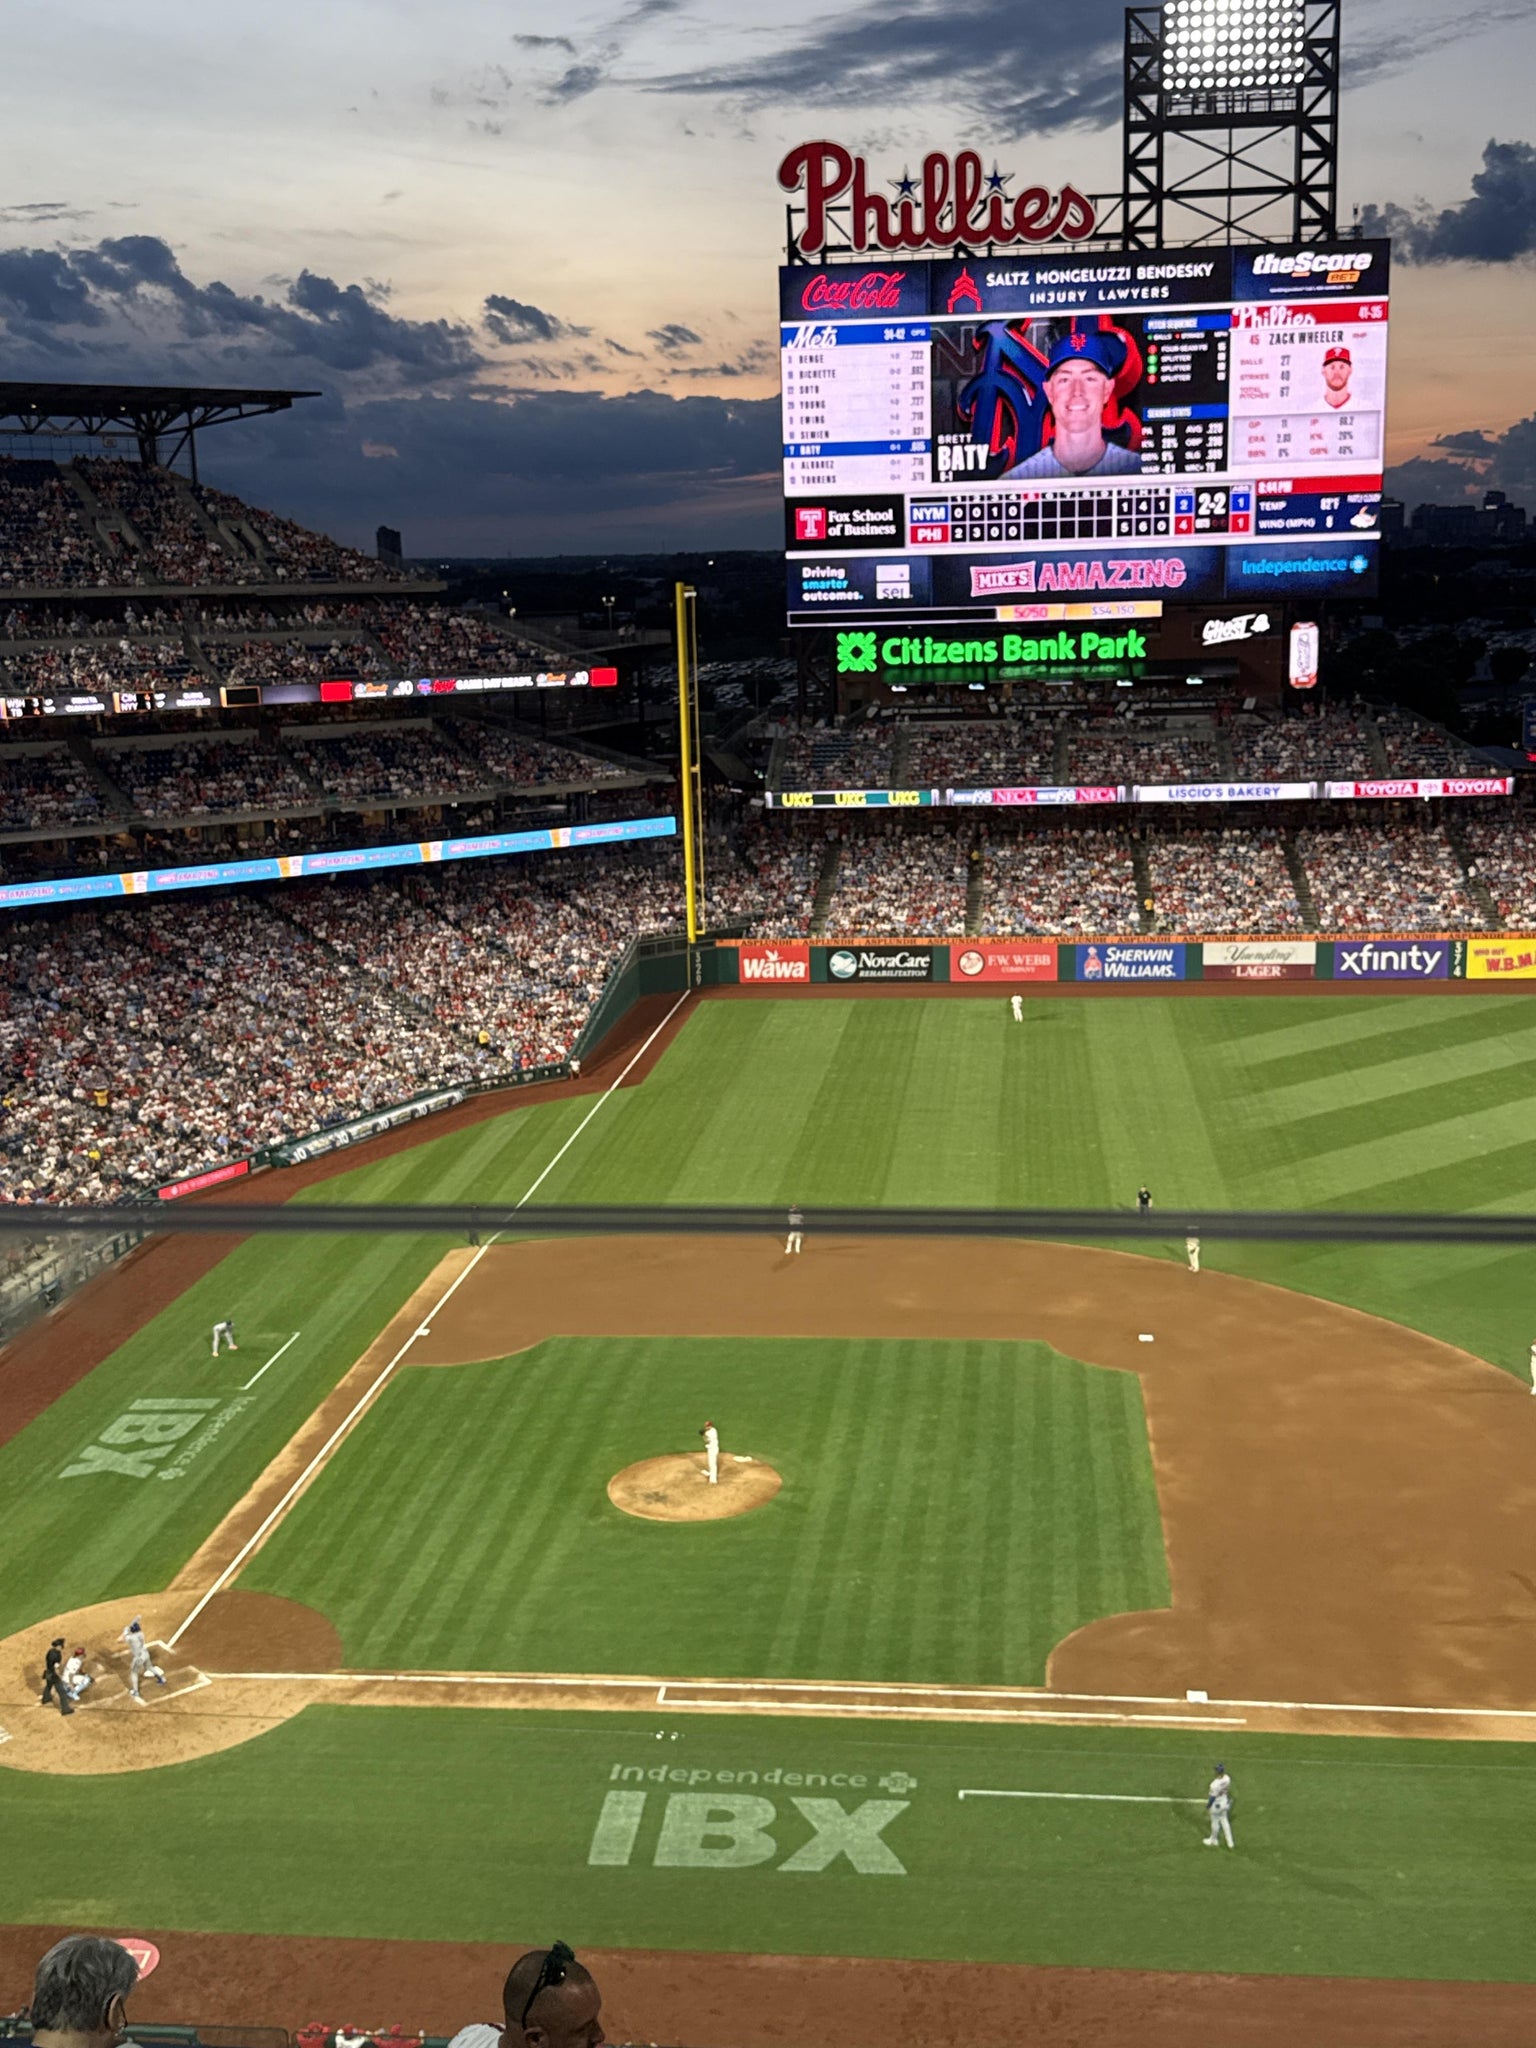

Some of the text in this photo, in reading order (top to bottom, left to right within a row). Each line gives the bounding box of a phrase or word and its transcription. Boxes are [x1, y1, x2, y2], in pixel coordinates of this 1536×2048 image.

[777, 139, 1096, 254] Phillies
[1252, 251, 1372, 275] theScore
[986, 262, 1214, 287] SALTZ MONGELUZZI BENDESKY
[1331, 273, 1356, 281] BET
[1030, 286, 1169, 304] INJURY LAWYERS
[1232, 304, 1317, 327] Phillies
[787, 325, 838, 347] Mets
[1249, 330, 1344, 345] 45 ZACK WHEELER
[799, 369, 836, 379] BICHETTE
[799, 385, 819, 394] SOTO
[800, 400, 825, 409] YOUNG
[800, 415, 825, 424] EWING
[801, 430, 829, 439] SEMIEN
[800, 445, 821, 455] BATY
[938, 444, 989, 470] BATY
[801, 460, 834, 470] ALVAREZ
[801, 475, 836, 484] TORRENS
[912, 500, 1166, 520] NYM 0 0 1 0 1 4 1
[1179, 499, 1188, 510] 2
[1198, 492, 1227, 515] 2-2
[1237, 497, 1244, 509] 1
[1259, 500, 1287, 511] TEMP
[828, 509, 893, 522] Fox School
[828, 522, 896, 536] of Business
[1179, 519, 1188, 530] 4
[1237, 517, 1244, 529] 1
[1258, 518, 1285, 529] WIND
[917, 528, 942, 541] PHI
[954, 528, 963, 539] 2
[972, 527, 981, 538] 3
[990, 526, 999, 538] 0
[1008, 525, 1018, 537] 0
[1121, 521, 1129, 533] 5
[1157, 520, 1167, 532] 0
[802, 566, 845, 580] Driving
[1242, 558, 1346, 576] Independence
[979, 570, 1029, 589] MIKE'S
[1038, 558, 1187, 591] AMAZING
[802, 579, 849, 590] smarter
[802, 590, 864, 601] outcomes.
[882, 629, 1146, 665] Citizens Bank Park
[994, 788, 1034, 801] NECA
[1077, 787, 1115, 800] NECA
[1168, 785, 1280, 799] LISCIO'S BAKERY
[1357, 781, 1502, 795] TOYOTA TOYOTA
[781, 791, 920, 807] UKG UKG UKG
[858, 952, 930, 968] NovaCare
[987, 954, 1051, 967] F.W. WEBB
[1105, 946, 1173, 962] SHERWIN
[1223, 944, 1295, 964] Yuengling
[1340, 943, 1442, 975] xfinity
[1453, 942, 1463, 977] 374
[1486, 951, 1536, 972] W.B.M
[743, 959, 806, 979] Wawa
[858, 969, 928, 977] REHABILITATION
[1001, 966, 1036, 974] COMPANY
[1235, 965, 1282, 976] LAGER
[58, 1398, 221, 1478] IBX
[610, 1763, 868, 1785] Independence
[587, 1790, 911, 1875] IBX
